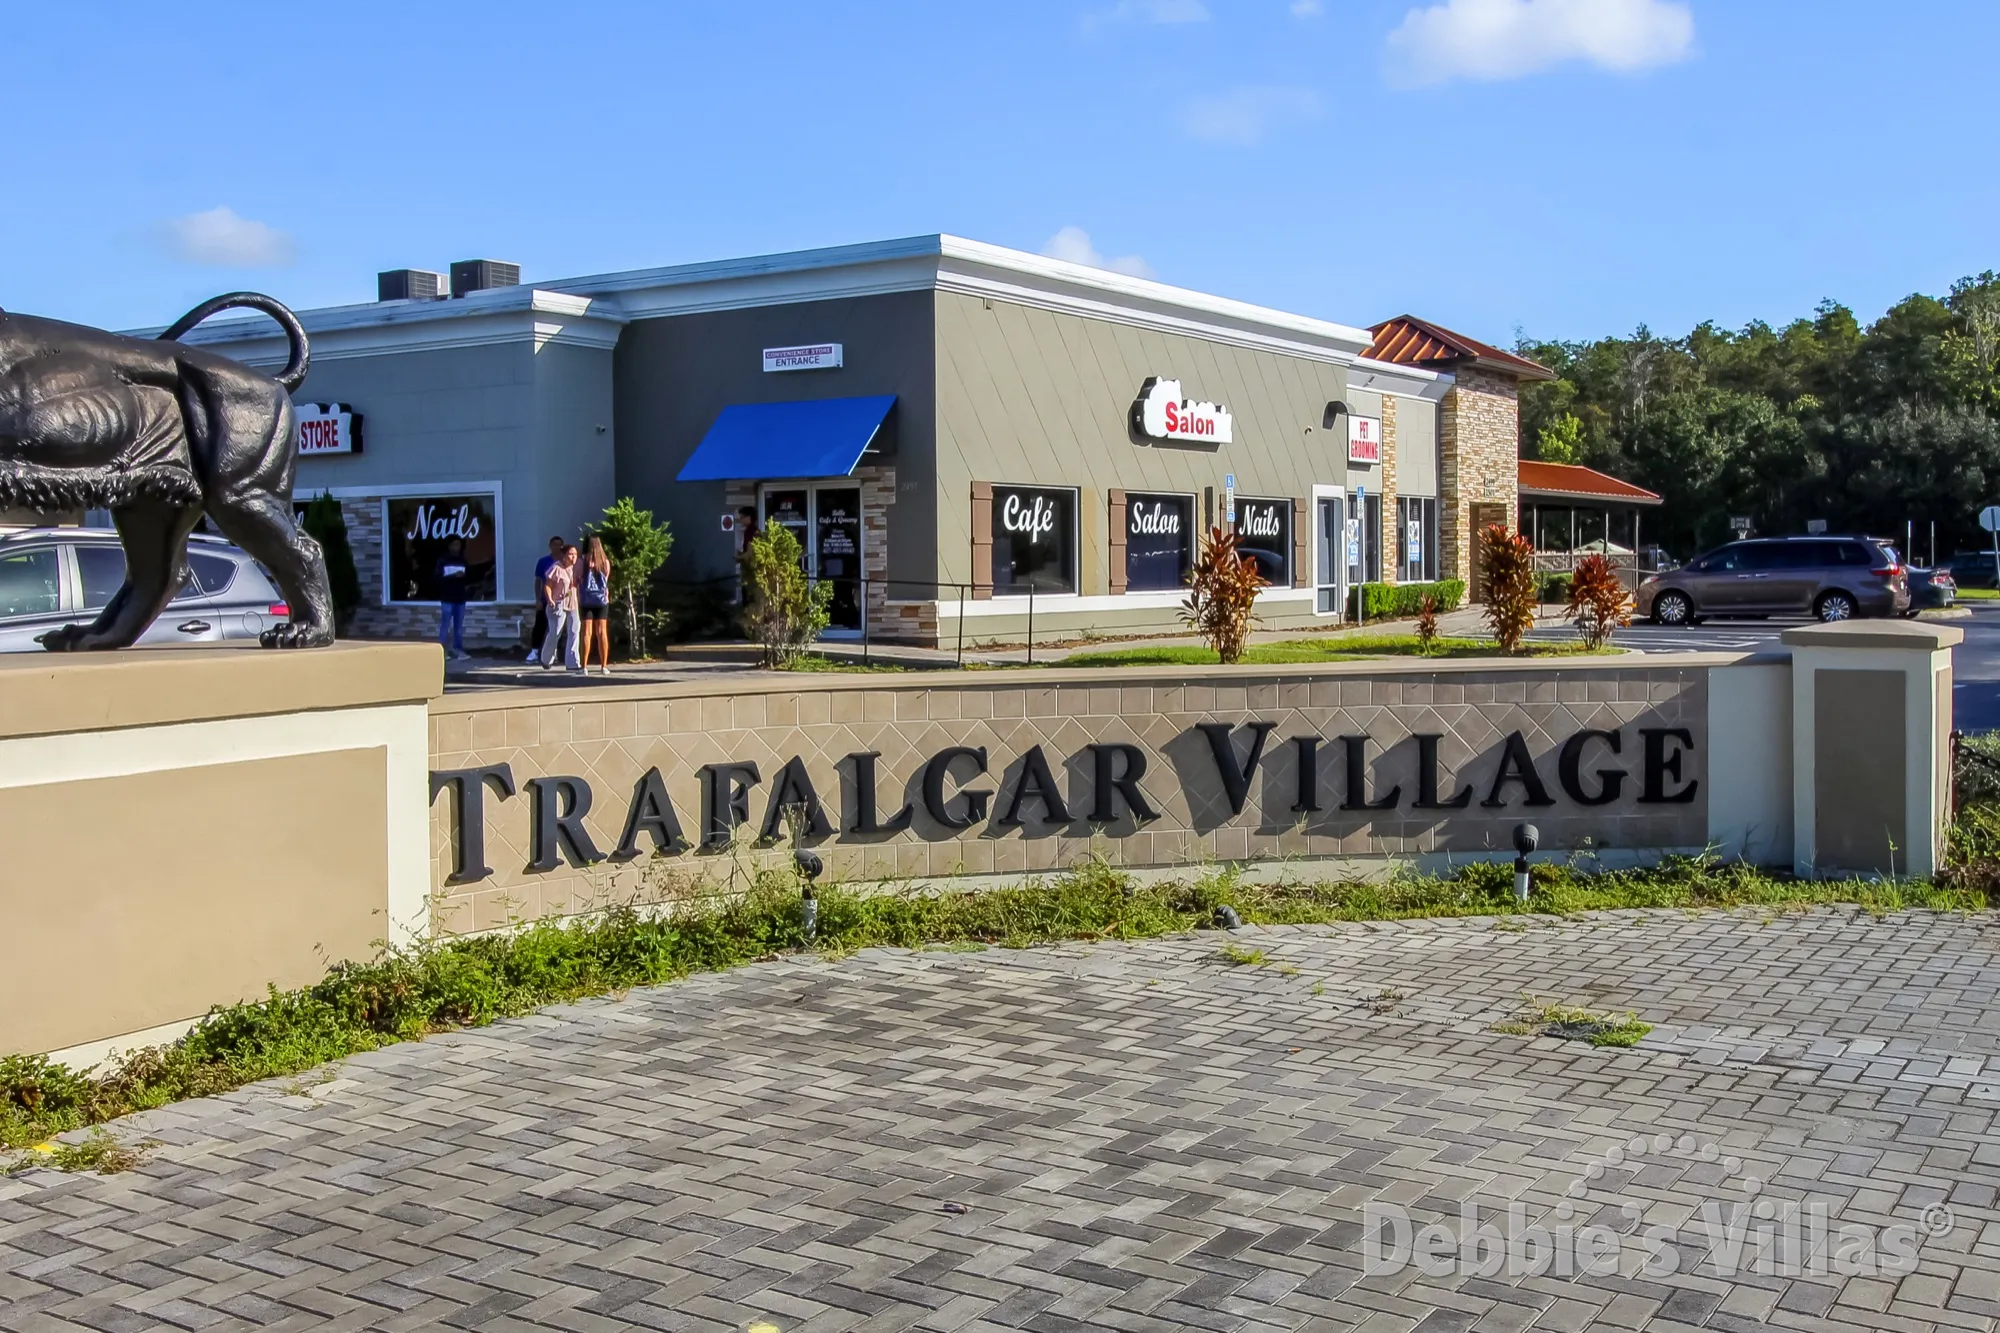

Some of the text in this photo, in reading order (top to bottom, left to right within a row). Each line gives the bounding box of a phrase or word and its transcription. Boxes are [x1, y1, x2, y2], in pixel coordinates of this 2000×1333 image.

[766, 347, 831, 358] CONVENIENCE STORE
[776, 356, 820, 366] ENTRANCE
[301, 419, 339, 450] STORE
[1165, 401, 1215, 436] Salon
[1359, 421, 1369, 440] PET
[1350, 439, 1379, 460] GROOMING
[407, 504, 479, 540] Nails
[1003, 494, 1054, 543] Café
[1131, 502, 1180, 534] Salon
[1238, 504, 1280, 536] Nails
[429, 720, 1699, 887] TRAFALGAR VILLAGE
